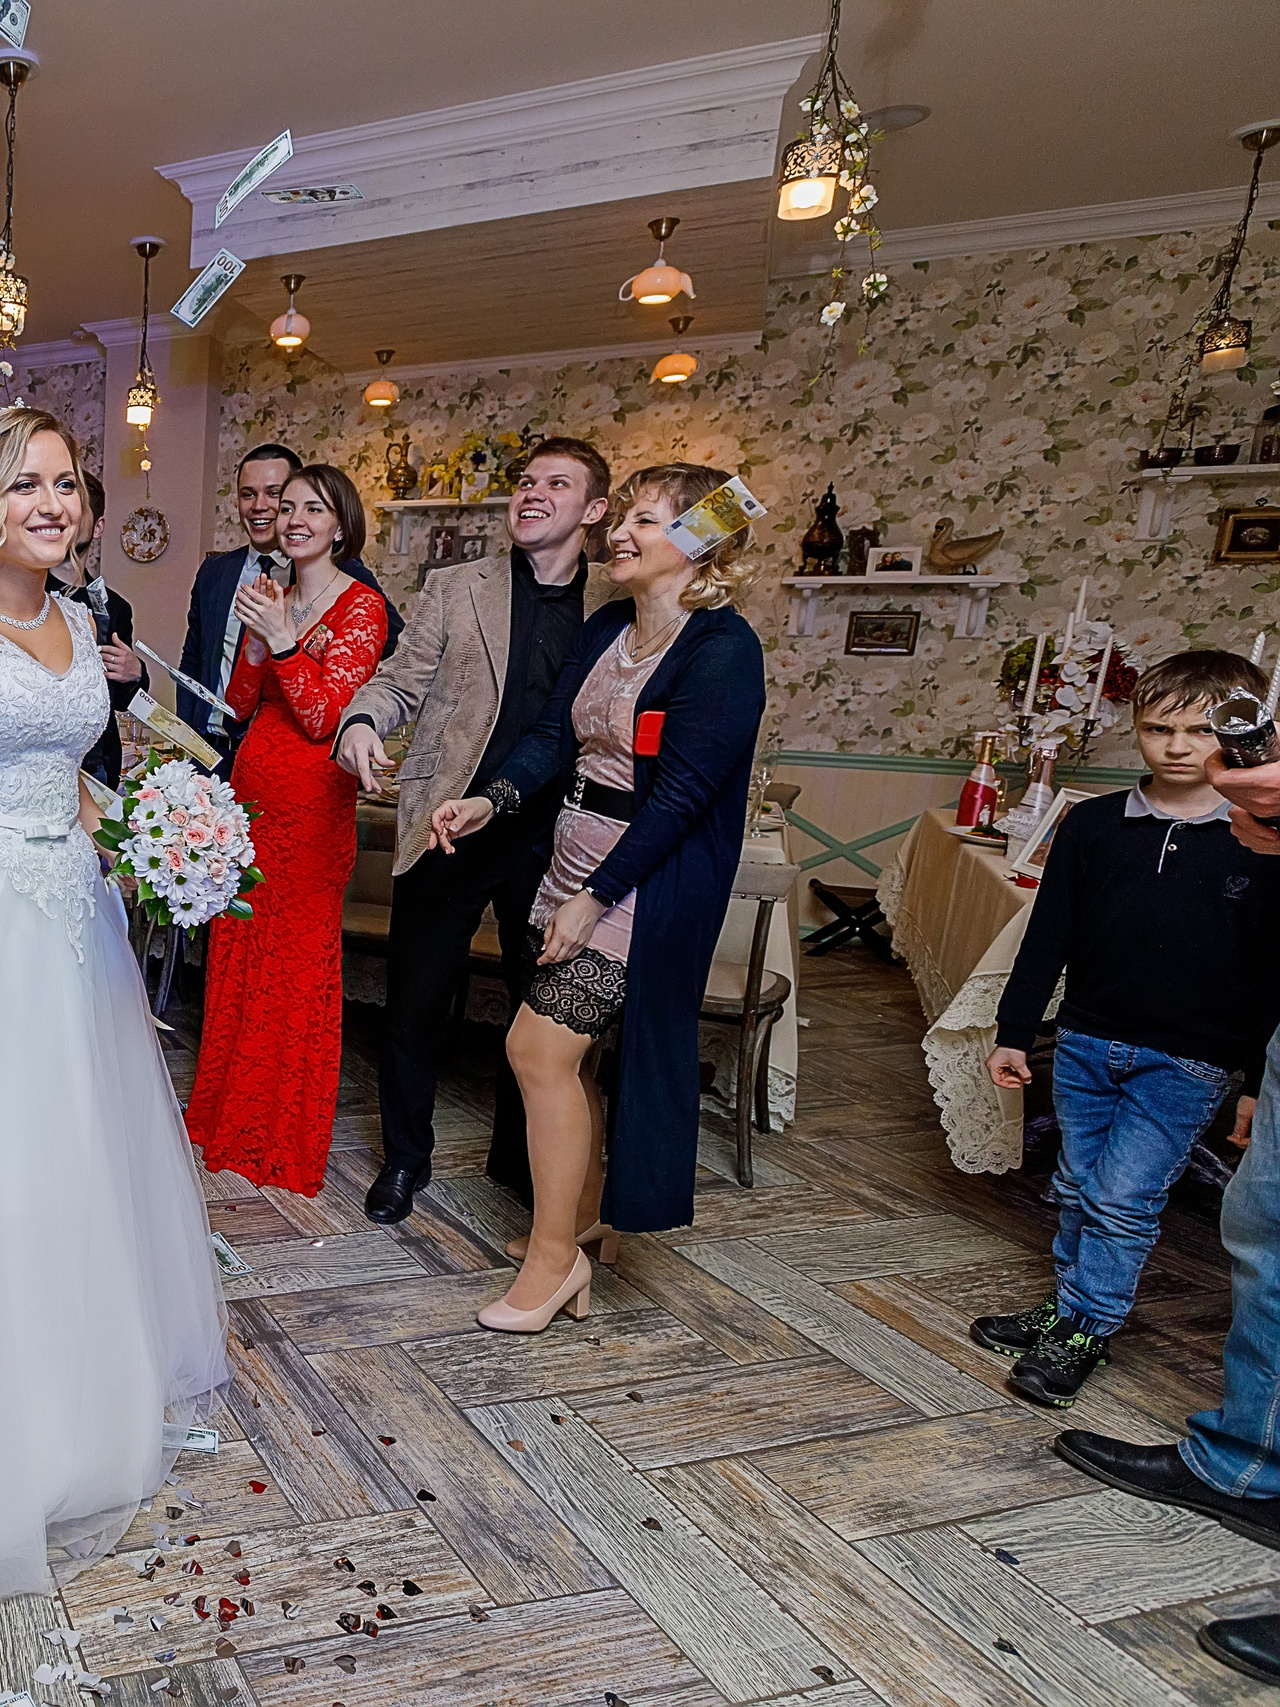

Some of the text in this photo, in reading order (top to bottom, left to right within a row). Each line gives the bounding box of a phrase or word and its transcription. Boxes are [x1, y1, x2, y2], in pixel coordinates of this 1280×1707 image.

[216, 255, 238, 275] 100
[703, 486, 735, 510] 200
[689, 547, 704, 558] 200
[139, 691, 156, 707] 200
[226, 1264, 247, 1273] 100
